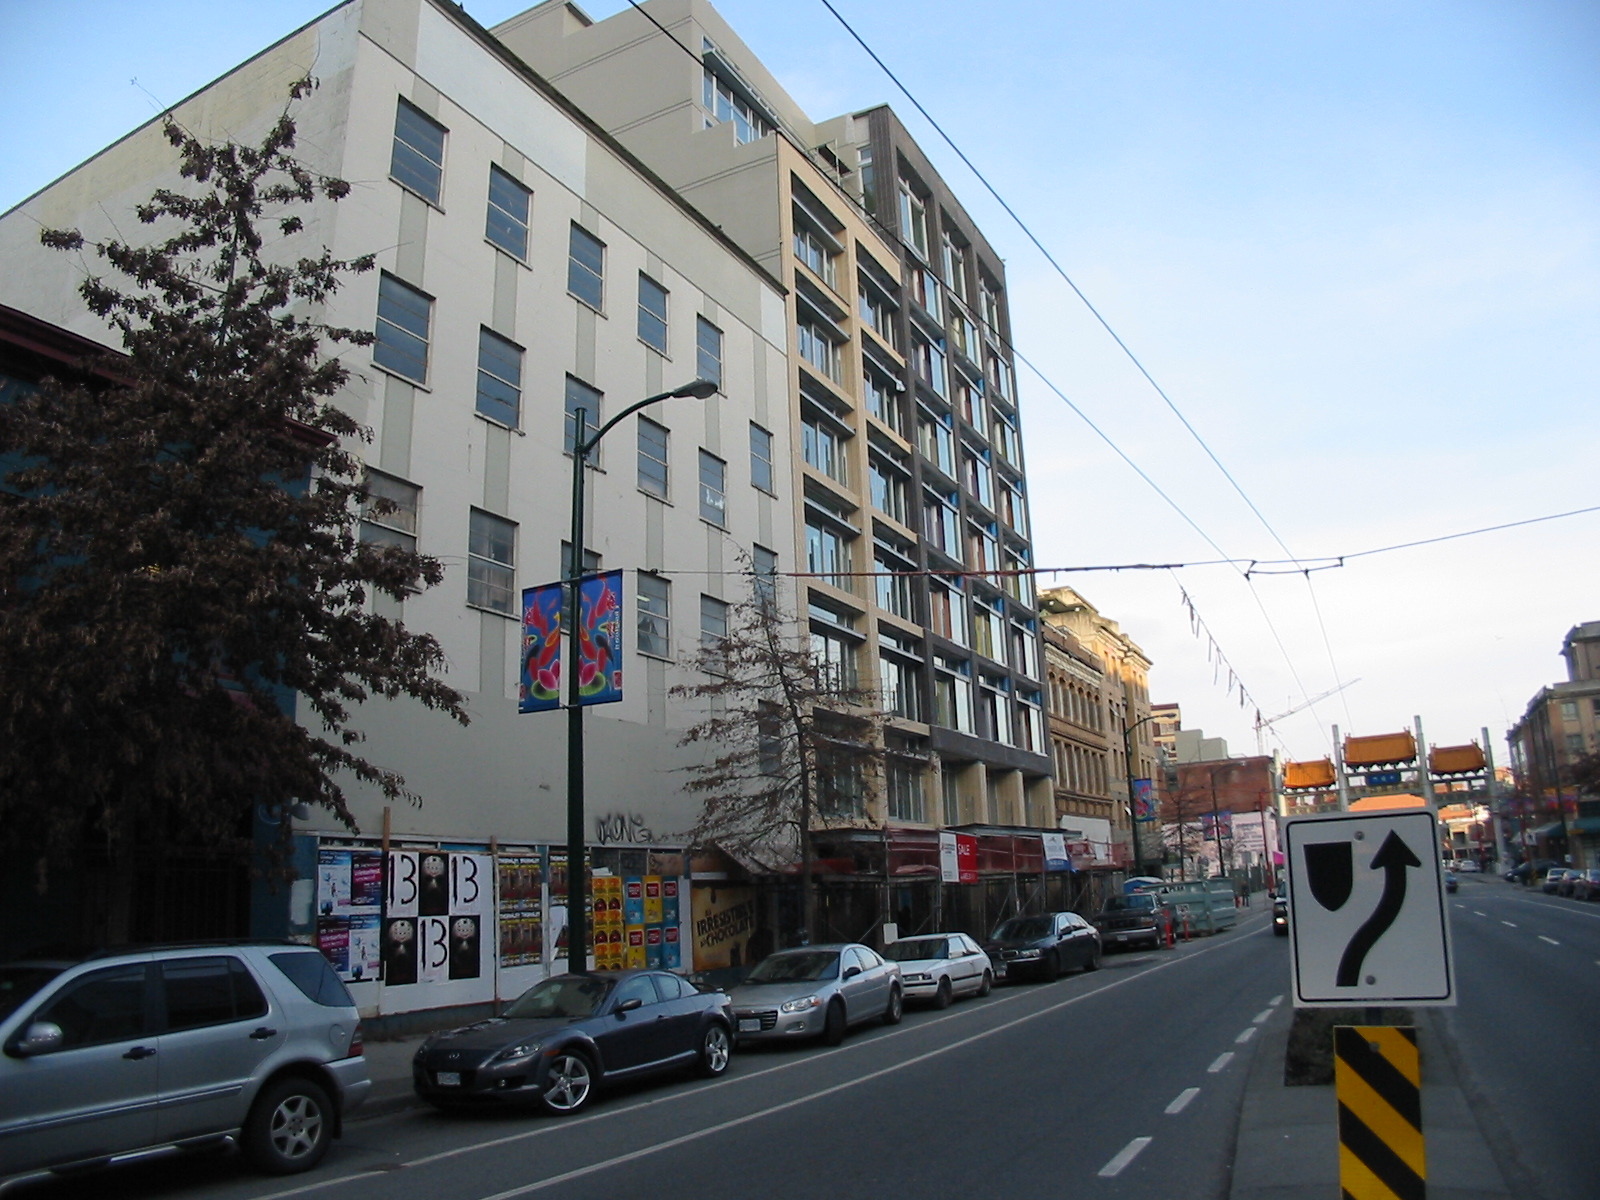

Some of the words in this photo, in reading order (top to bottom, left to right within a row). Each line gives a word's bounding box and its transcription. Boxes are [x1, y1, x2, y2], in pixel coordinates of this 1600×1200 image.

[958, 843, 970, 856] SALE
[389, 854, 417, 908] 13
[452, 855, 479, 907] 13
[421, 918, 447, 972] 13
